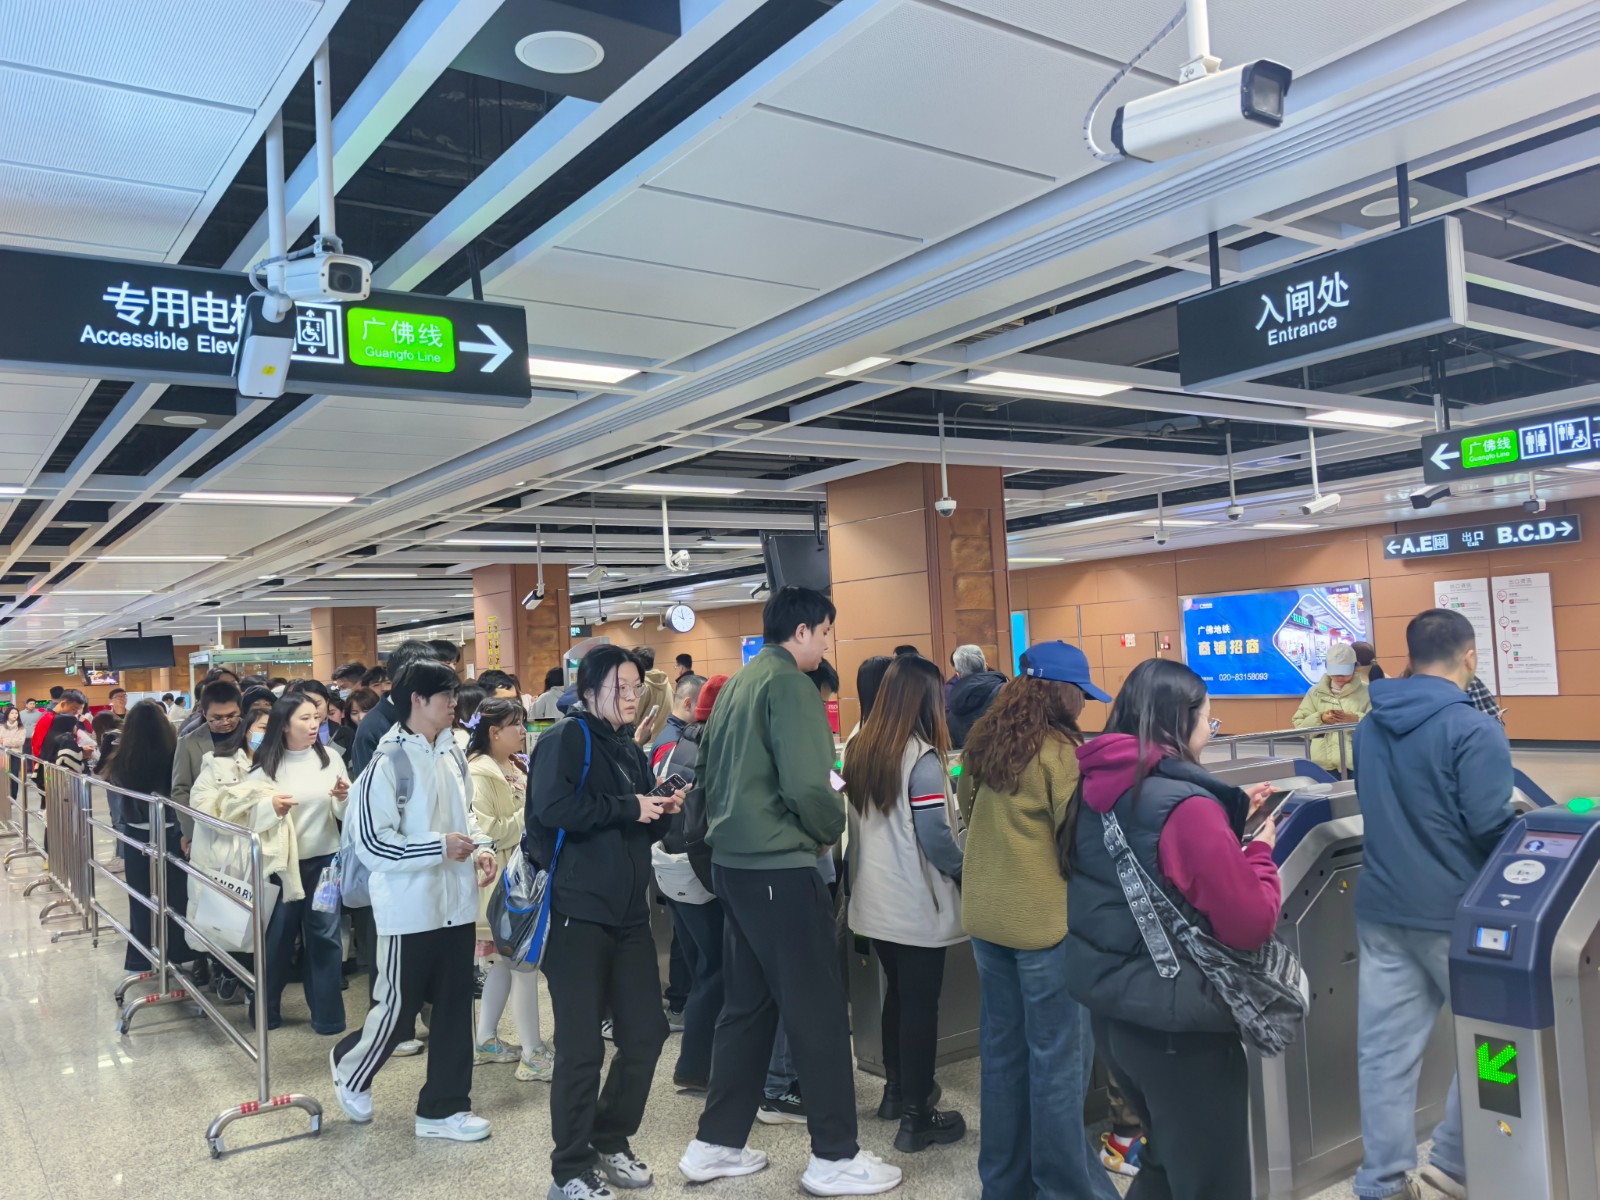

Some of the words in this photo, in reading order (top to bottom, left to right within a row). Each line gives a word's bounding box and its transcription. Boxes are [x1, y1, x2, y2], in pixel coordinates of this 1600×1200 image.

[1255, 271, 1350, 331] 入闸处
[80, 324, 189, 351] Accessible
[362, 317, 443, 348] 广佛线
[1268, 316, 1338, 346] Entrance
[365, 346, 415, 362] Guangfo
[417, 351, 441, 363] Line
[1469, 436, 1512, 455] 广佛线
[1461, 531, 1484, 543] 出口
[1497, 522, 1556, 544] B.C.D
[1197, 624, 1231, 635] 广佛地铁
[1198, 638, 1260, 656] 商铺招商
